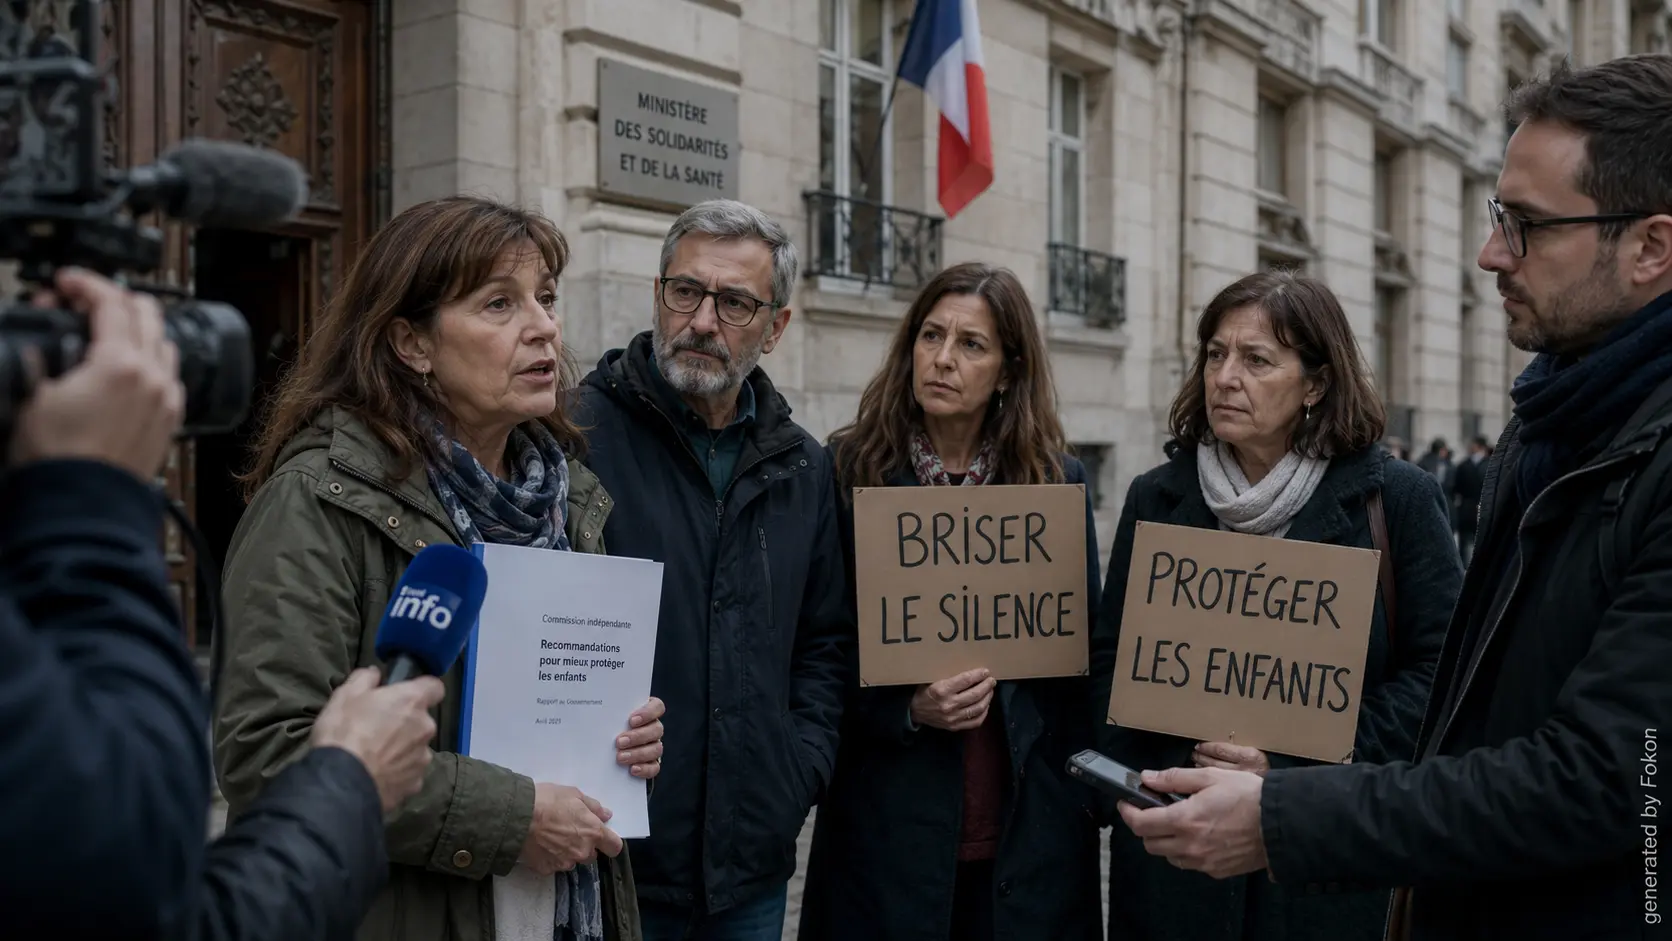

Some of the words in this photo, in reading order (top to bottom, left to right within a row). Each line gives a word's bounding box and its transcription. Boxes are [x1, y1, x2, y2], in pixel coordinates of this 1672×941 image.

[638, 92, 708, 125] MINISTÈRE
[614, 119, 642, 141] DES
[648, 127, 728, 160] SOLIDARITÉS
[620, 153, 636, 172] ET
[641, 158, 659, 177] DE
[663, 162, 680, 181] LA
[684, 166, 724, 190] SANTÉ
[389, 586, 452, 629] info
[1146, 551, 1341, 629] PROTÉGER
[542, 614, 586, 626] Commission
[587, 618, 632, 629] indépendante
[881, 595, 922, 644] LE
[539, 657, 561, 667] pour
[562, 656, 589, 667] mieux
[590, 658, 625, 670] protéger
[540, 639, 621, 653] Recommandations
[538, 670, 552, 681] les
[554, 670, 587, 682] enfants
[1131, 636, 1191, 688] LES
[1204, 648, 1351, 713] ENFANTS
